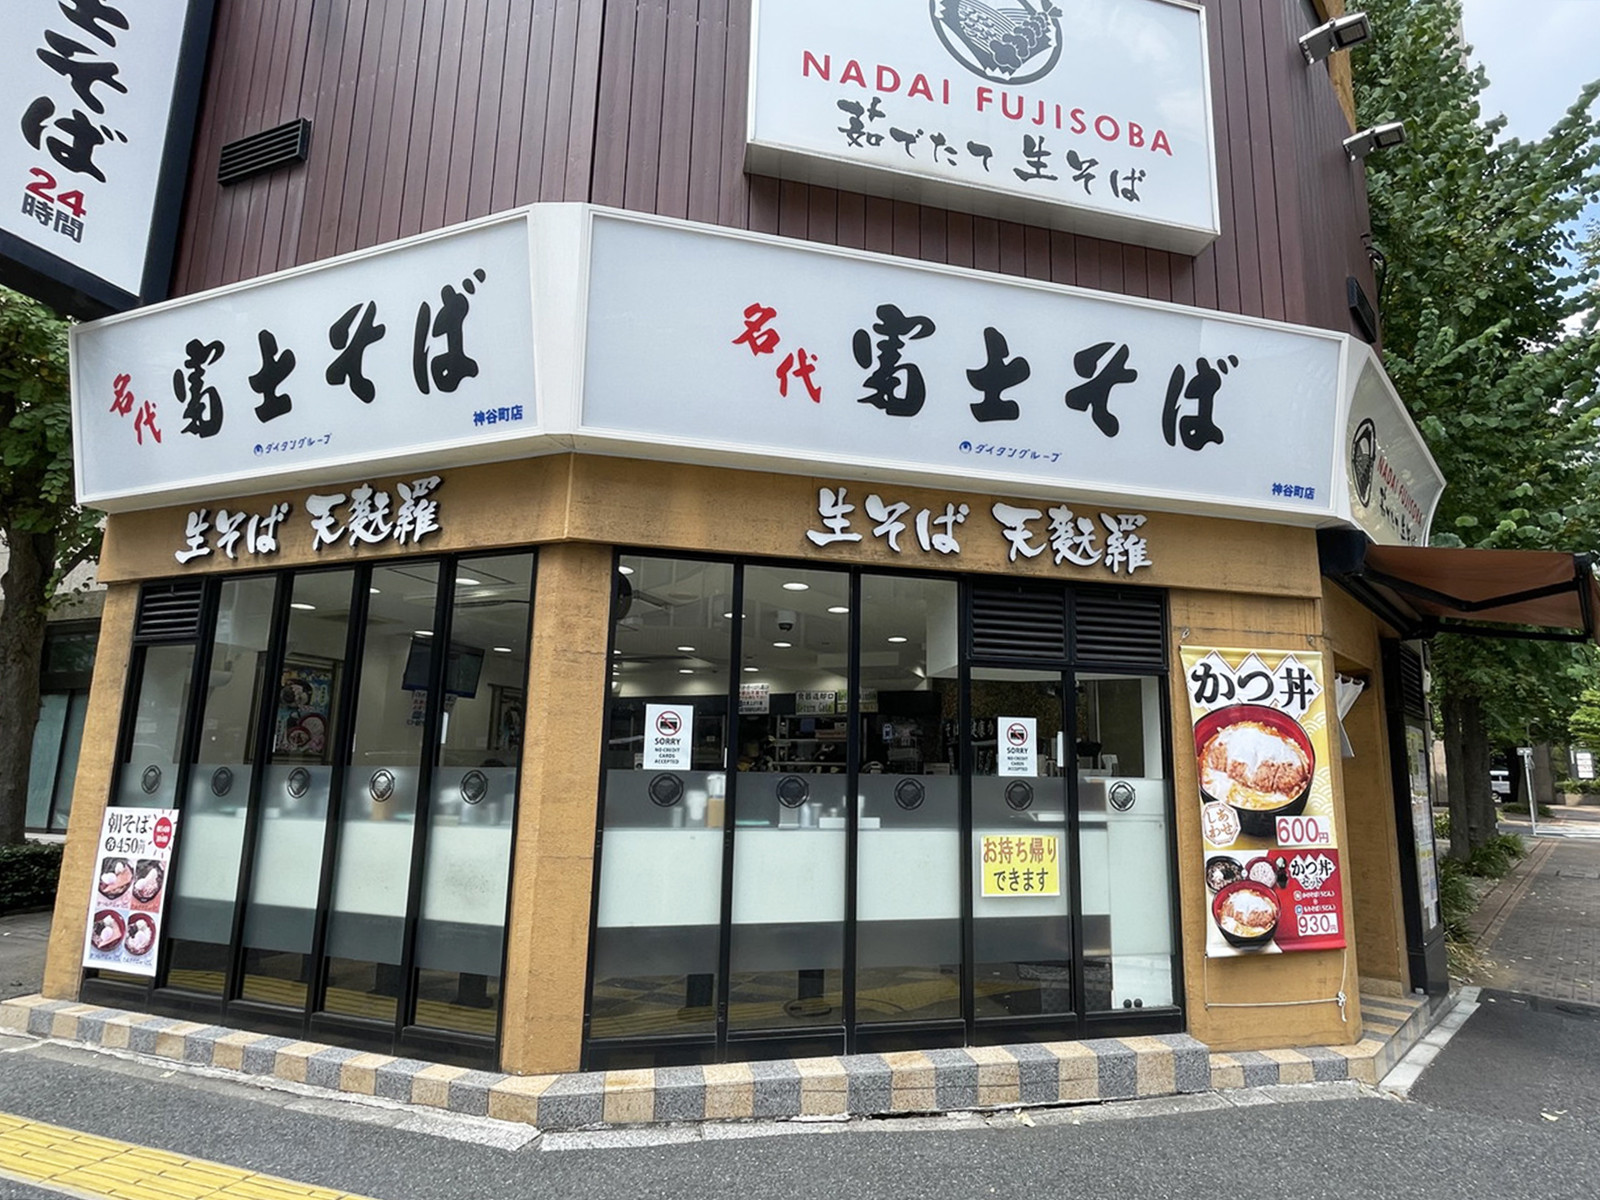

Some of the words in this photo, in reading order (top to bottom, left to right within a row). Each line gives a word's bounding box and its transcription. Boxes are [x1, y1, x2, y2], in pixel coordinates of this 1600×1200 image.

[802, 49, 950, 105] NADAI
[975, 86, 1174, 157] FUJISOBA
[836, 96, 994, 173] 茹でたて
[1012, 134, 1147, 202] 生そば
[25, 167, 87, 218] 24
[21, 192, 84, 243] 時間
[109, 372, 162, 445] 名代
[173, 268, 486, 438] 富士そば
[731, 302, 822, 404] 名代
[852, 303, 1239, 451] 富士そば
[473, 405, 523, 427] 神谷町店
[265, 433, 332, 454] ダイタングループ
[975, 443, 1062, 463] ダイタングループ
[1271, 482, 1315, 500] 神谷町店
[174, 502, 290, 564] 生そば
[806, 486, 970, 554] 生そば
[1190, 661, 1316, 709] かつ丼
[654, 737, 681, 745] SORRY
[108, 812, 151, 834] 朝そば
[1277, 817, 1330, 843] 600円
[984, 837, 1056, 864] お持ち帰り
[993, 867, 1049, 892] できます
[1291, 860, 1332, 876] かつ丼
[1299, 914, 1337, 933] 930円
